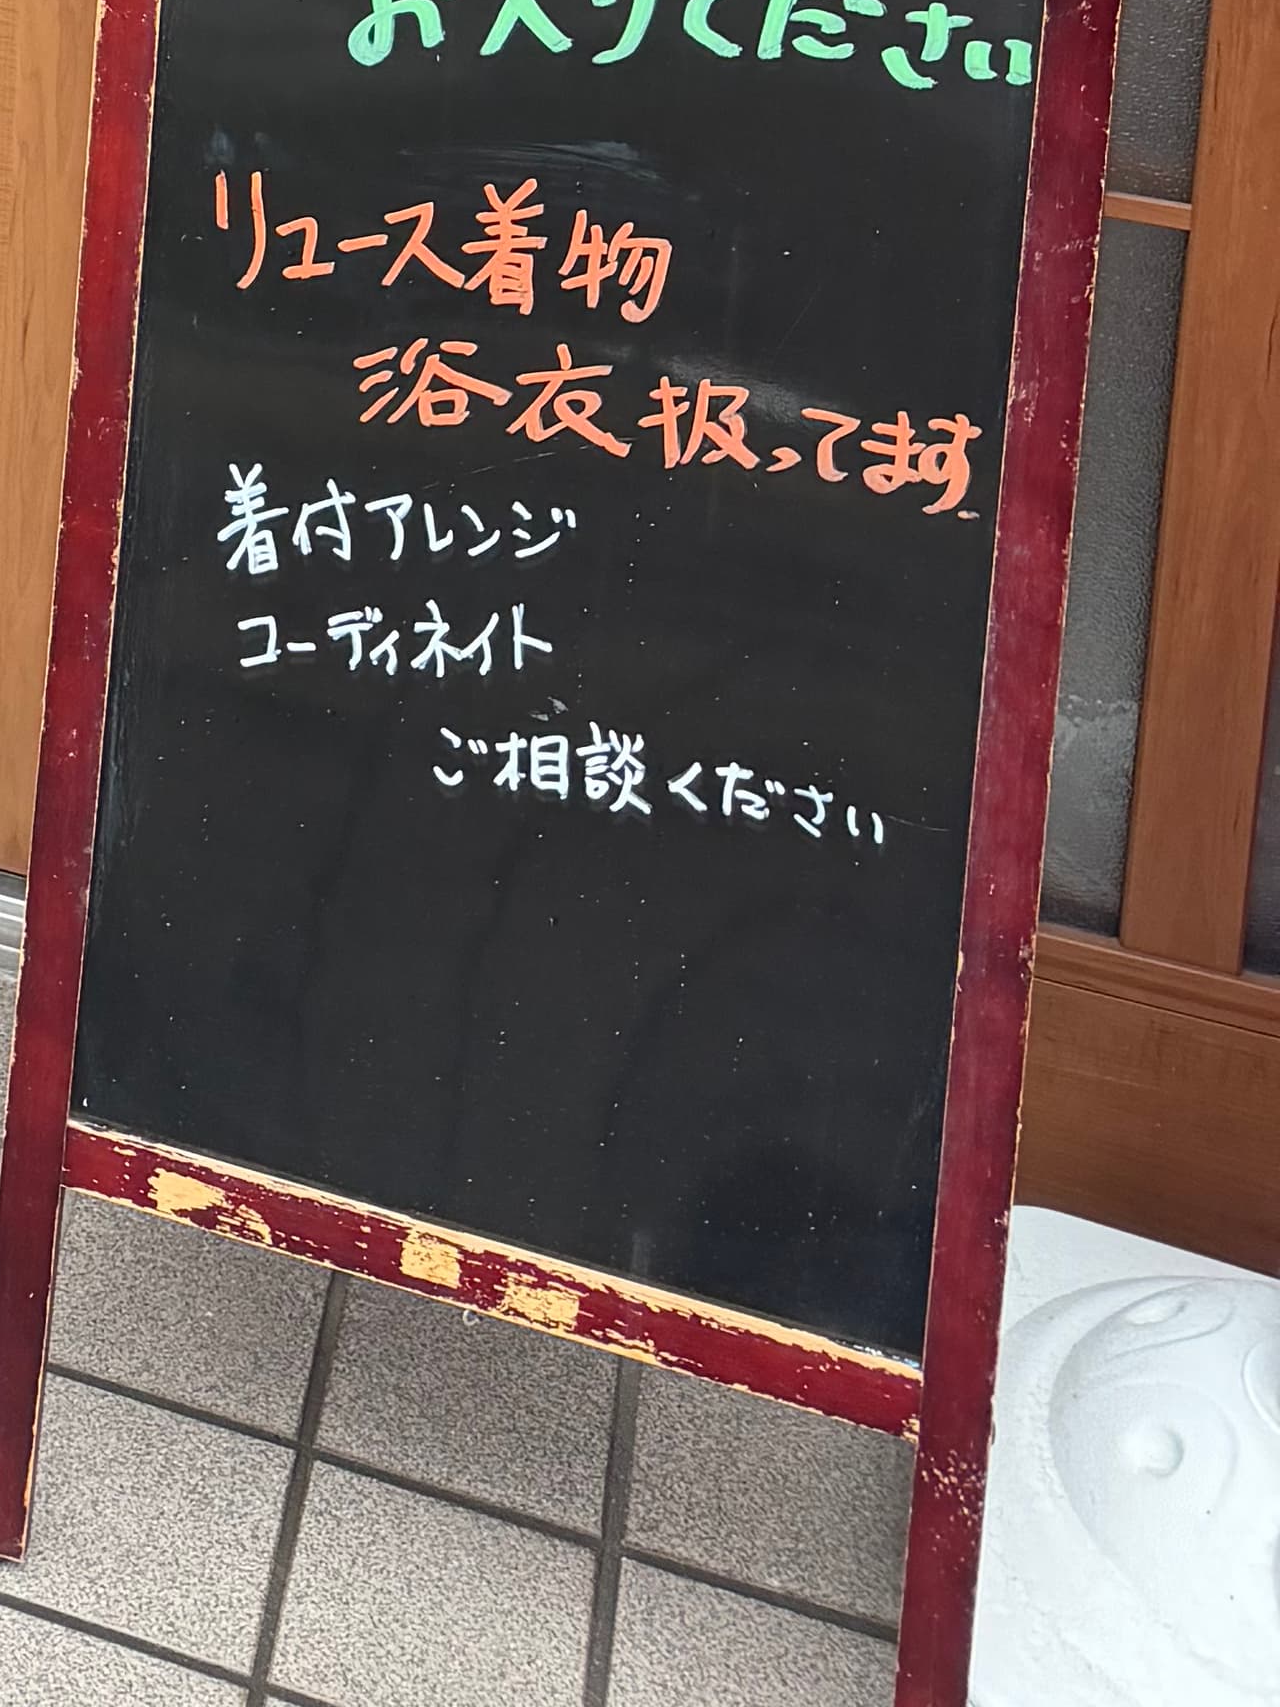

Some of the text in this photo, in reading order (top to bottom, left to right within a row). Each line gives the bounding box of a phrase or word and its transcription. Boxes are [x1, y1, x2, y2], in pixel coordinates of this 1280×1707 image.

[214, 170, 673, 322] リュース着物
[216, 465, 576, 575] 着付アレンジ
[237, 605, 554, 677] コーディネイト
[433, 725, 886, 845] ご相談ください
